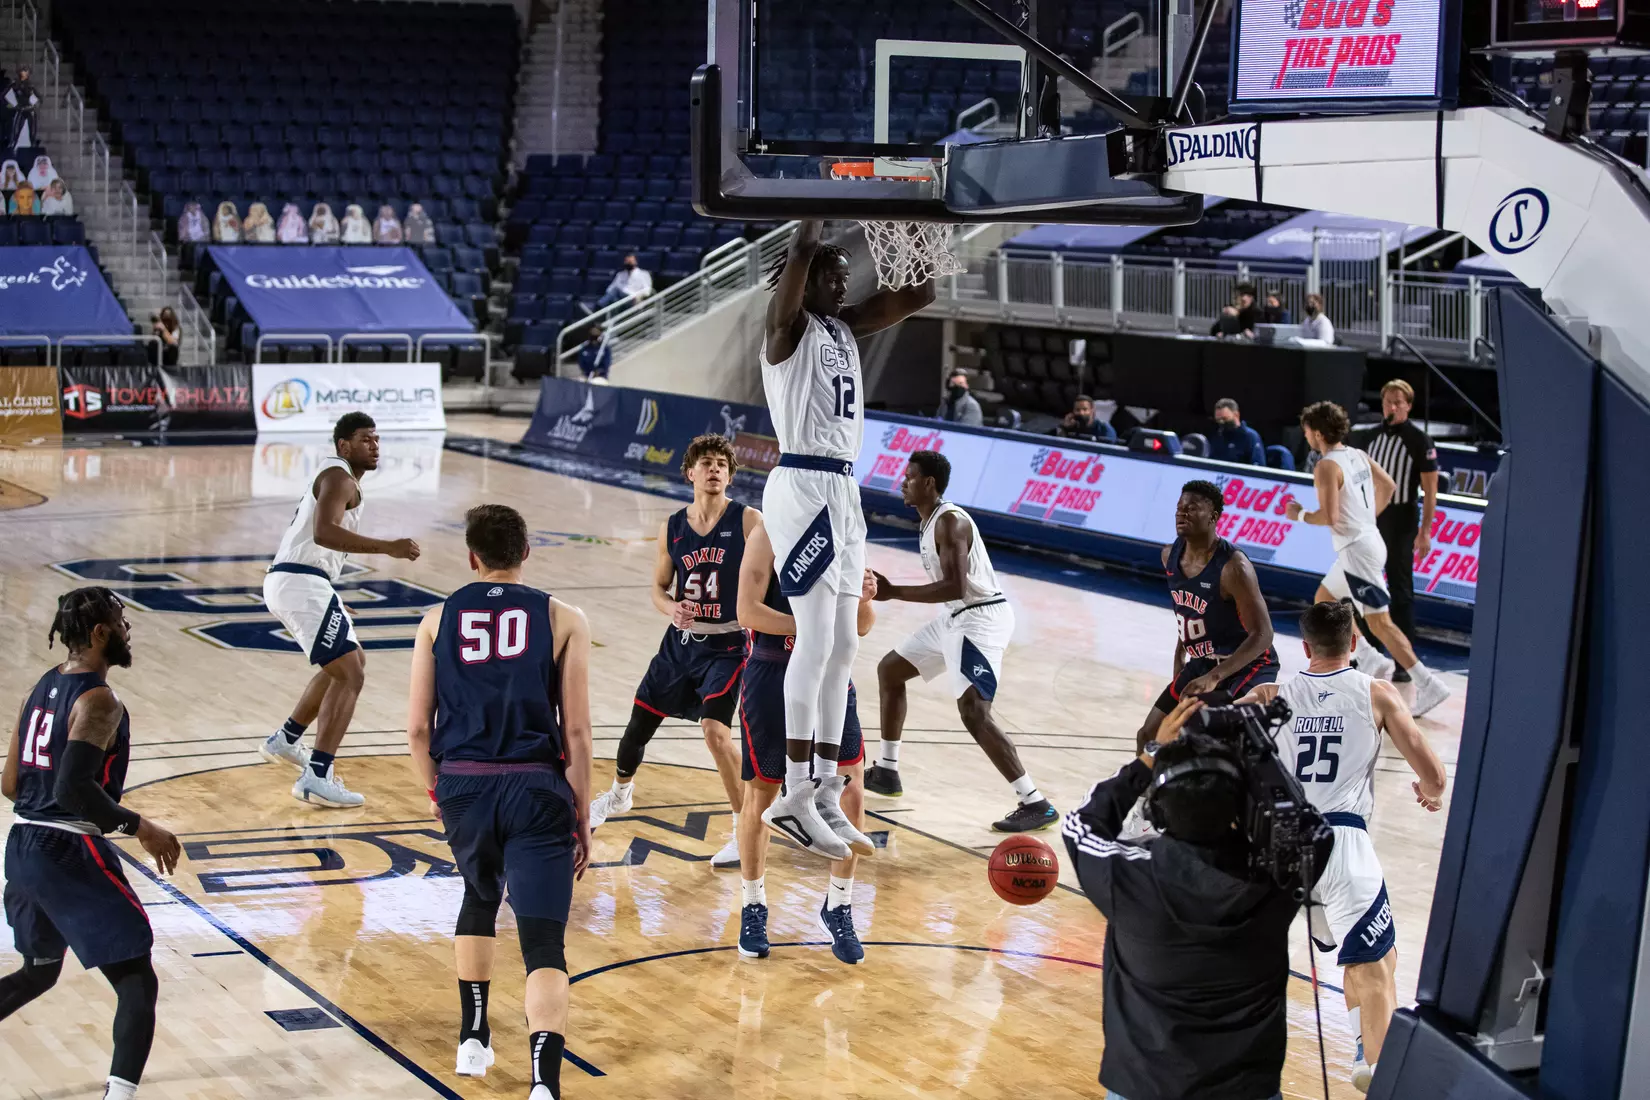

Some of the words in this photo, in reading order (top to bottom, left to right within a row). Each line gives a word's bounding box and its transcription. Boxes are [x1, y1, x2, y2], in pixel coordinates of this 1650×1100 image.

[1273, 37, 1333, 89] TIRE
[1325, 33, 1402, 88] PROS
[1168, 125, 1257, 166] SPALDING
[245, 274, 426, 289] GuideStone
[316, 388, 436, 404] MAGNOLIA
[832, 373, 856, 420] 12
[862, 453, 905, 486] TIRE
[1039, 450, 1105, 484] Bud's
[1010, 479, 1058, 513] TIRE
[1044, 485, 1102, 521] PROS
[1223, 477, 1296, 516] Bud's
[1231, 517, 1293, 547] PROS
[681, 547, 726, 571] DIXIE
[787, 532, 829, 584] LANCERS
[684, 570, 719, 600] 54
[1171, 589, 1208, 615] DIXIE
[320, 609, 343, 649] LANCERS
[458, 607, 530, 664] 50
[21, 705, 54, 770] 12
[1294, 716, 1345, 733] ROWELL
[1295, 735, 1343, 783] 25
[1005, 852, 1053, 868] Wilson
[1011, 876, 1047, 889] NCAA
